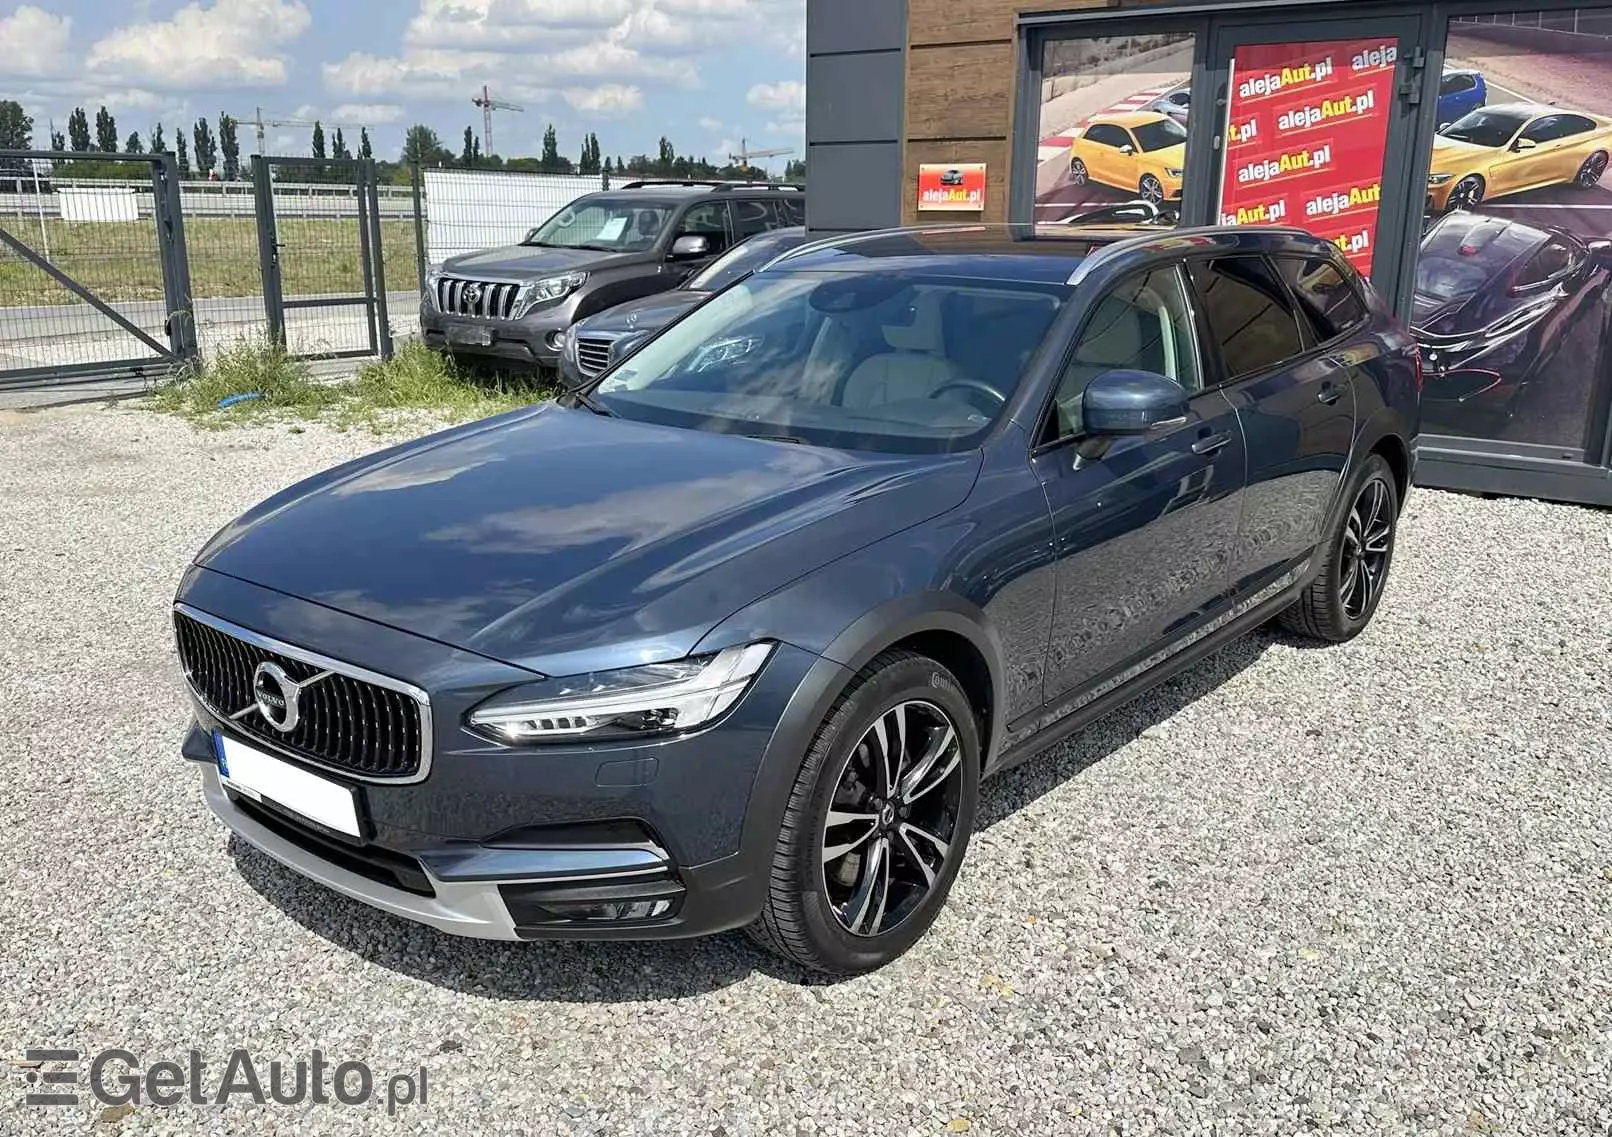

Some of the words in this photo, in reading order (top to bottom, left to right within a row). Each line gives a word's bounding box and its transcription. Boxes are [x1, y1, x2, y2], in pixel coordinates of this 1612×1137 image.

[1352, 45, 1396, 70] aleja
[1239, 57, 1332, 97] alejaAut.pl
[1278, 90, 1374, 129] alejaAut.pl
[1229, 119, 1257, 142] t.pl
[1238, 145, 1331, 182] alejaAut.pl
[922, 188, 981, 204] alejaAut.pl
[1305, 184, 1381, 215] alejaAut
